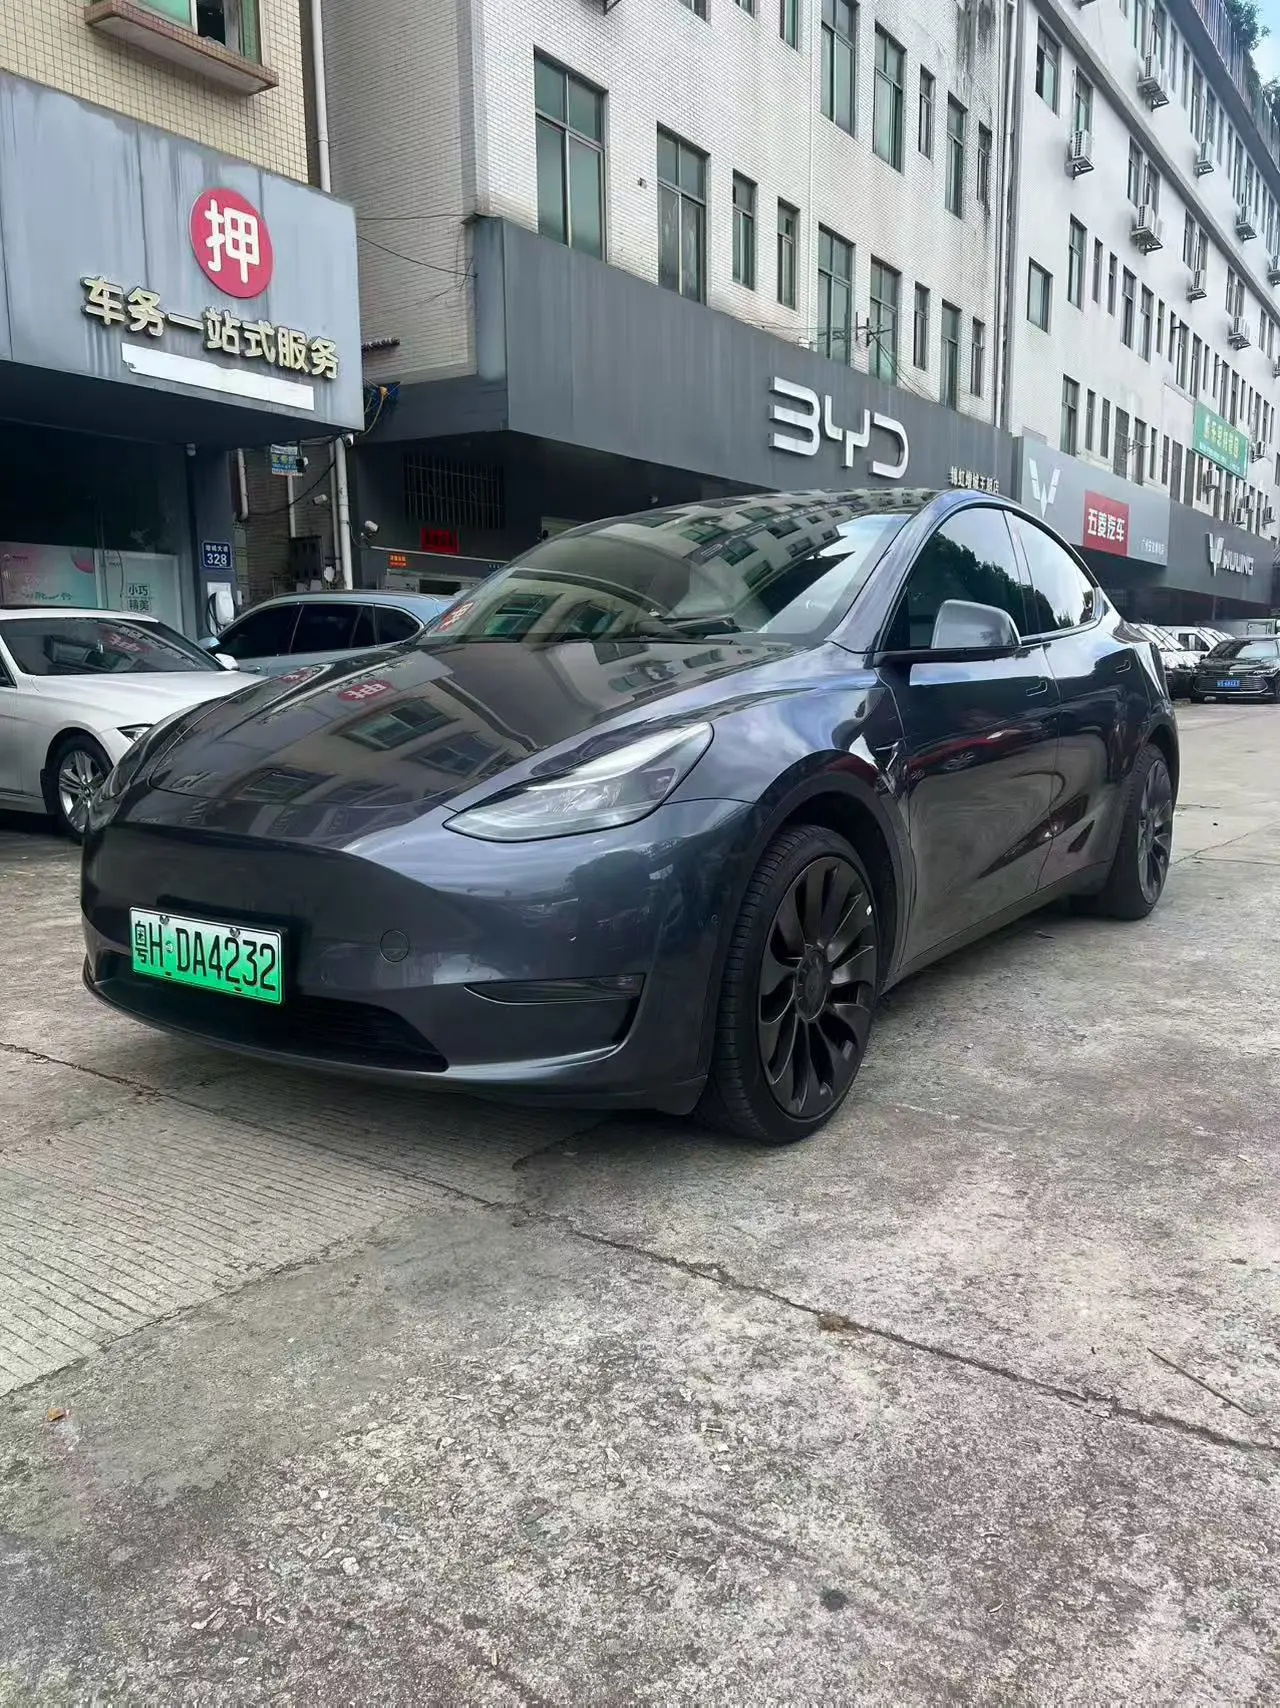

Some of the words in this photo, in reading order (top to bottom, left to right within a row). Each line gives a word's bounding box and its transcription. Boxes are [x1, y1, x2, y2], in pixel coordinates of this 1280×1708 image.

[204, 198, 260, 283] 押
[82, 275, 340, 380] 车务一站式服务
[769, 376, 909, 479] BYD
[1087, 508, 1125, 543] 五菱汽车
[207, 553, 227, 565] 328
[1222, 548, 1255, 576] WULING
